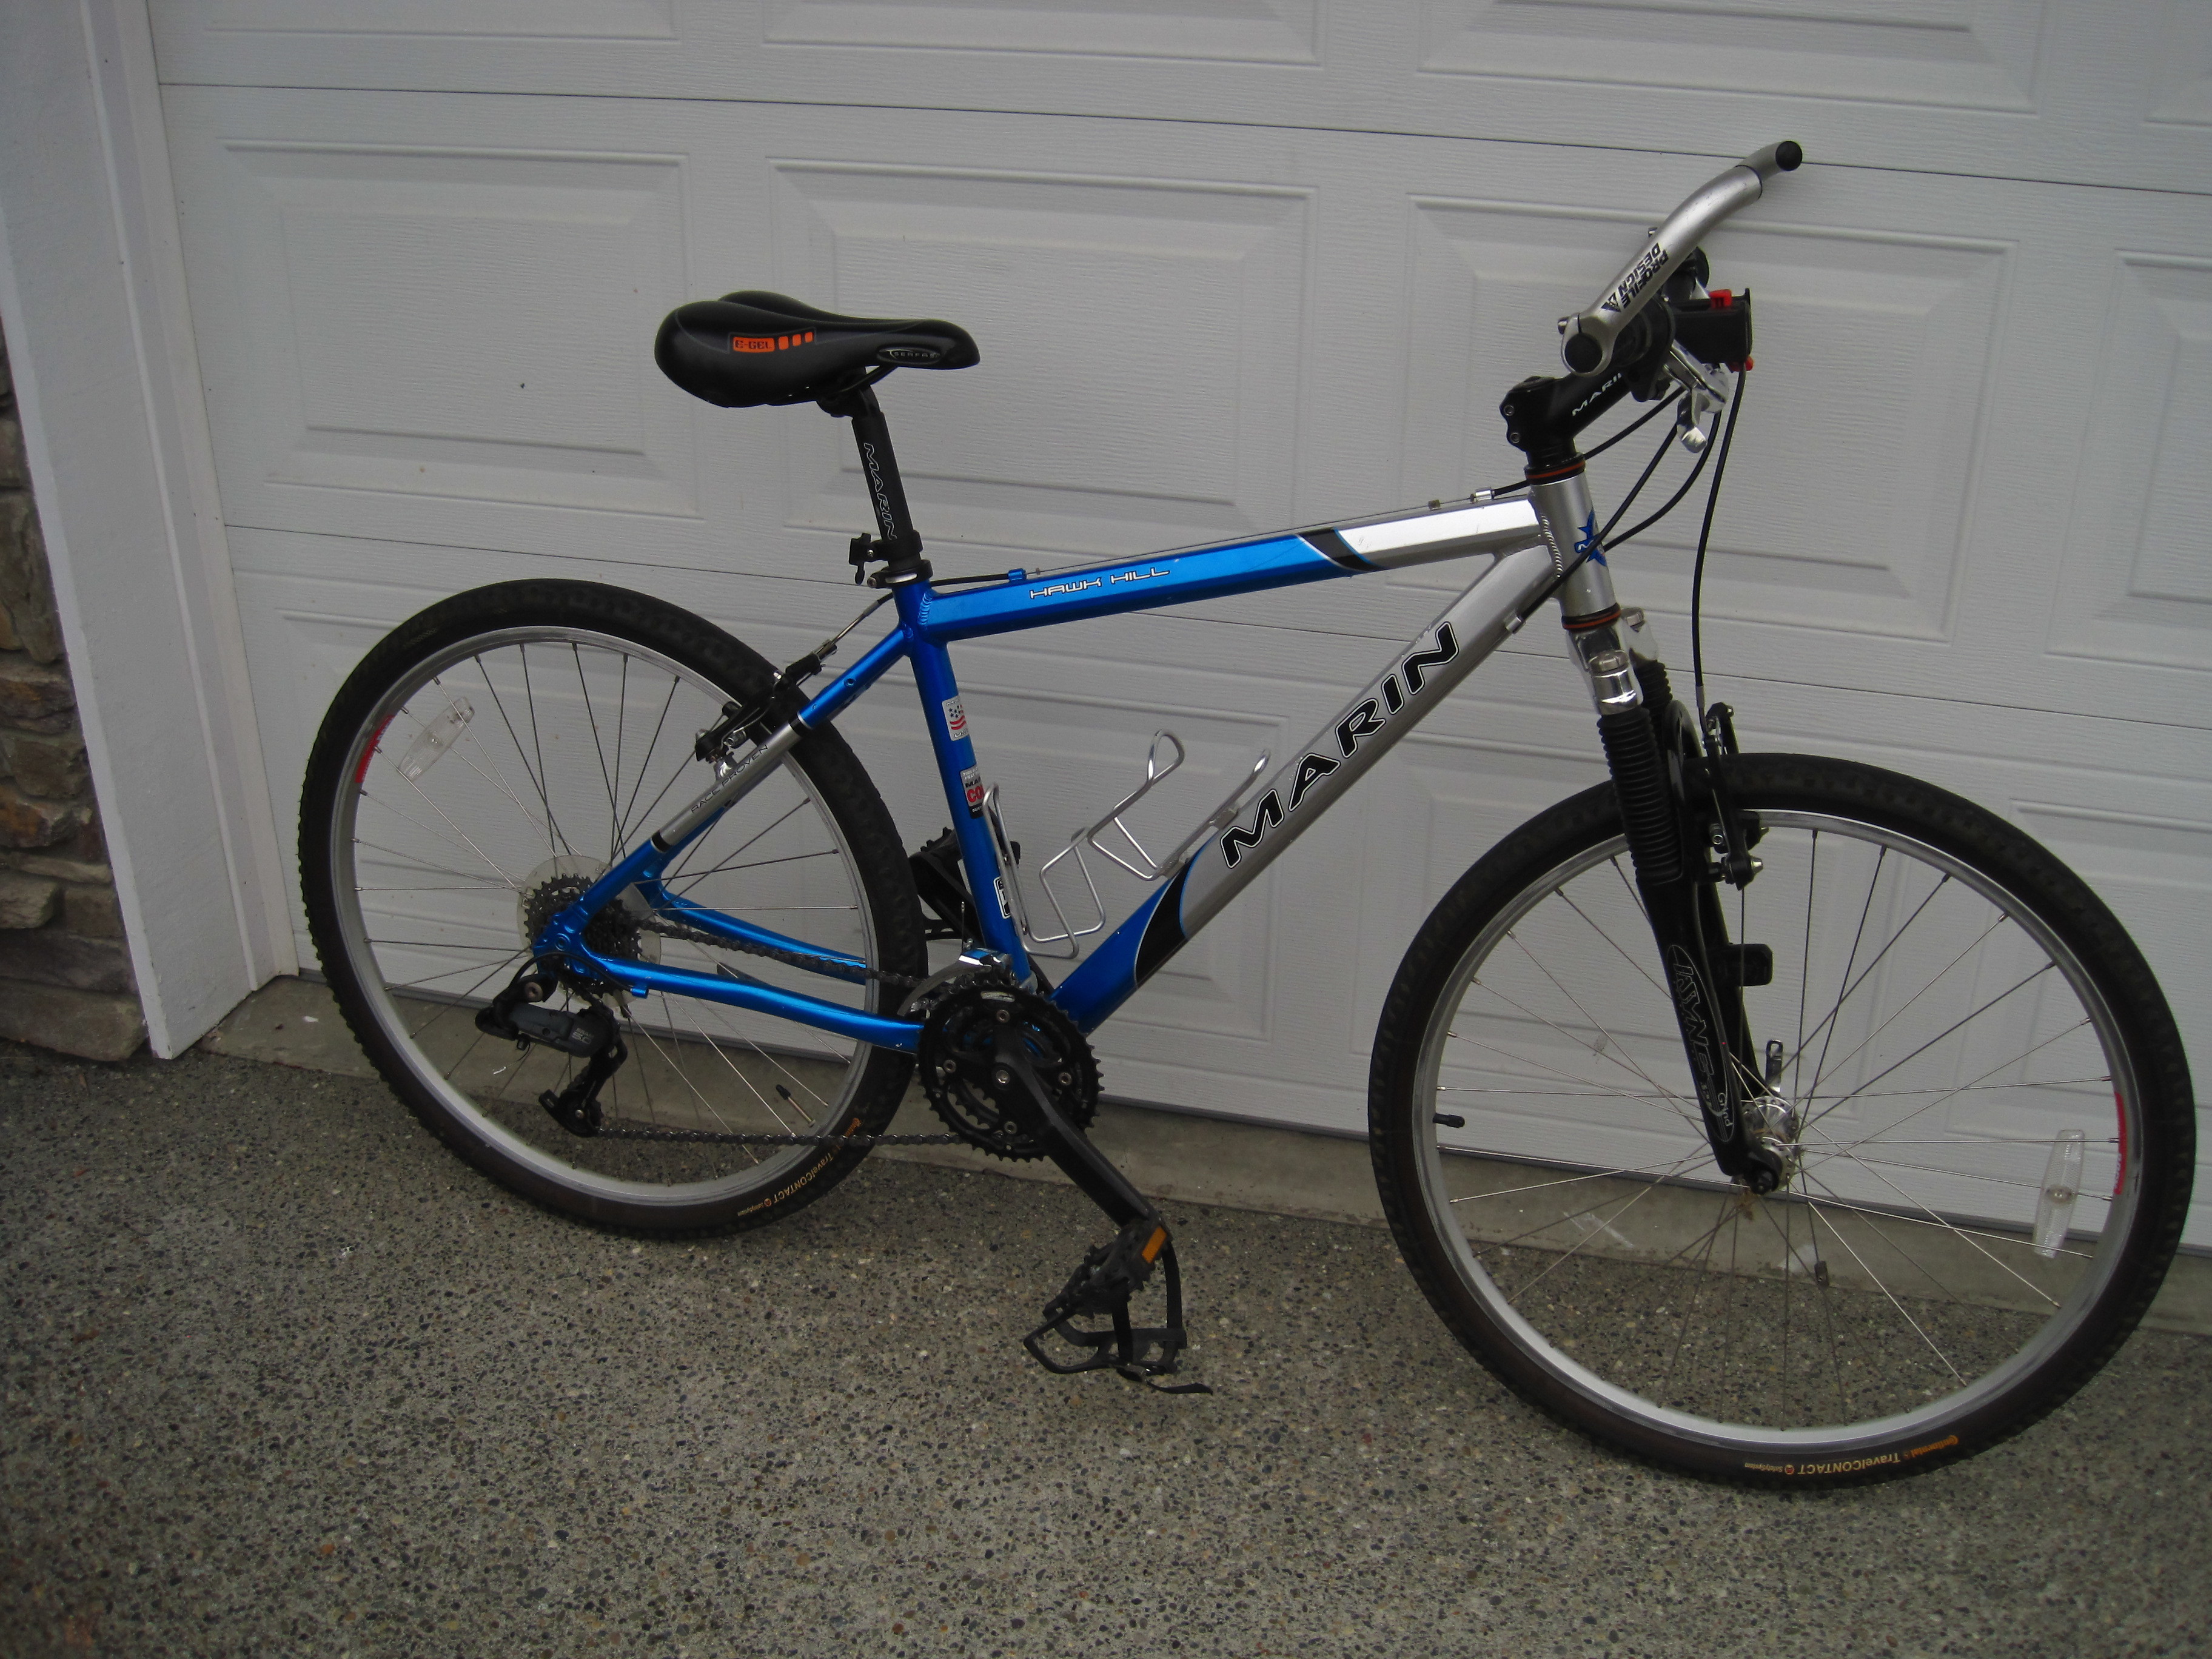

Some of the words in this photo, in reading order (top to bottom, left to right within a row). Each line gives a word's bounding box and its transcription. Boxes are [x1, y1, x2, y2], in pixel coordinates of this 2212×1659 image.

[1617, 243, 1661, 297] DESIGN
[1621, 249, 1669, 309] PROFILE
[734, 340, 772, 350] E-GEL
[863, 442, 898, 540] MARIN
[1030, 577, 1102, 599] HAWK
[1110, 567, 1170, 584] HILL
[1220, 621, 1460, 869] MARIN
[691, 788, 720, 813] RACE
[720, 744, 769, 788] PROVEN
[774, 1152, 834, 1204] TravelCONTACT
[1797, 1453, 1900, 1475] TravelCONTACT
